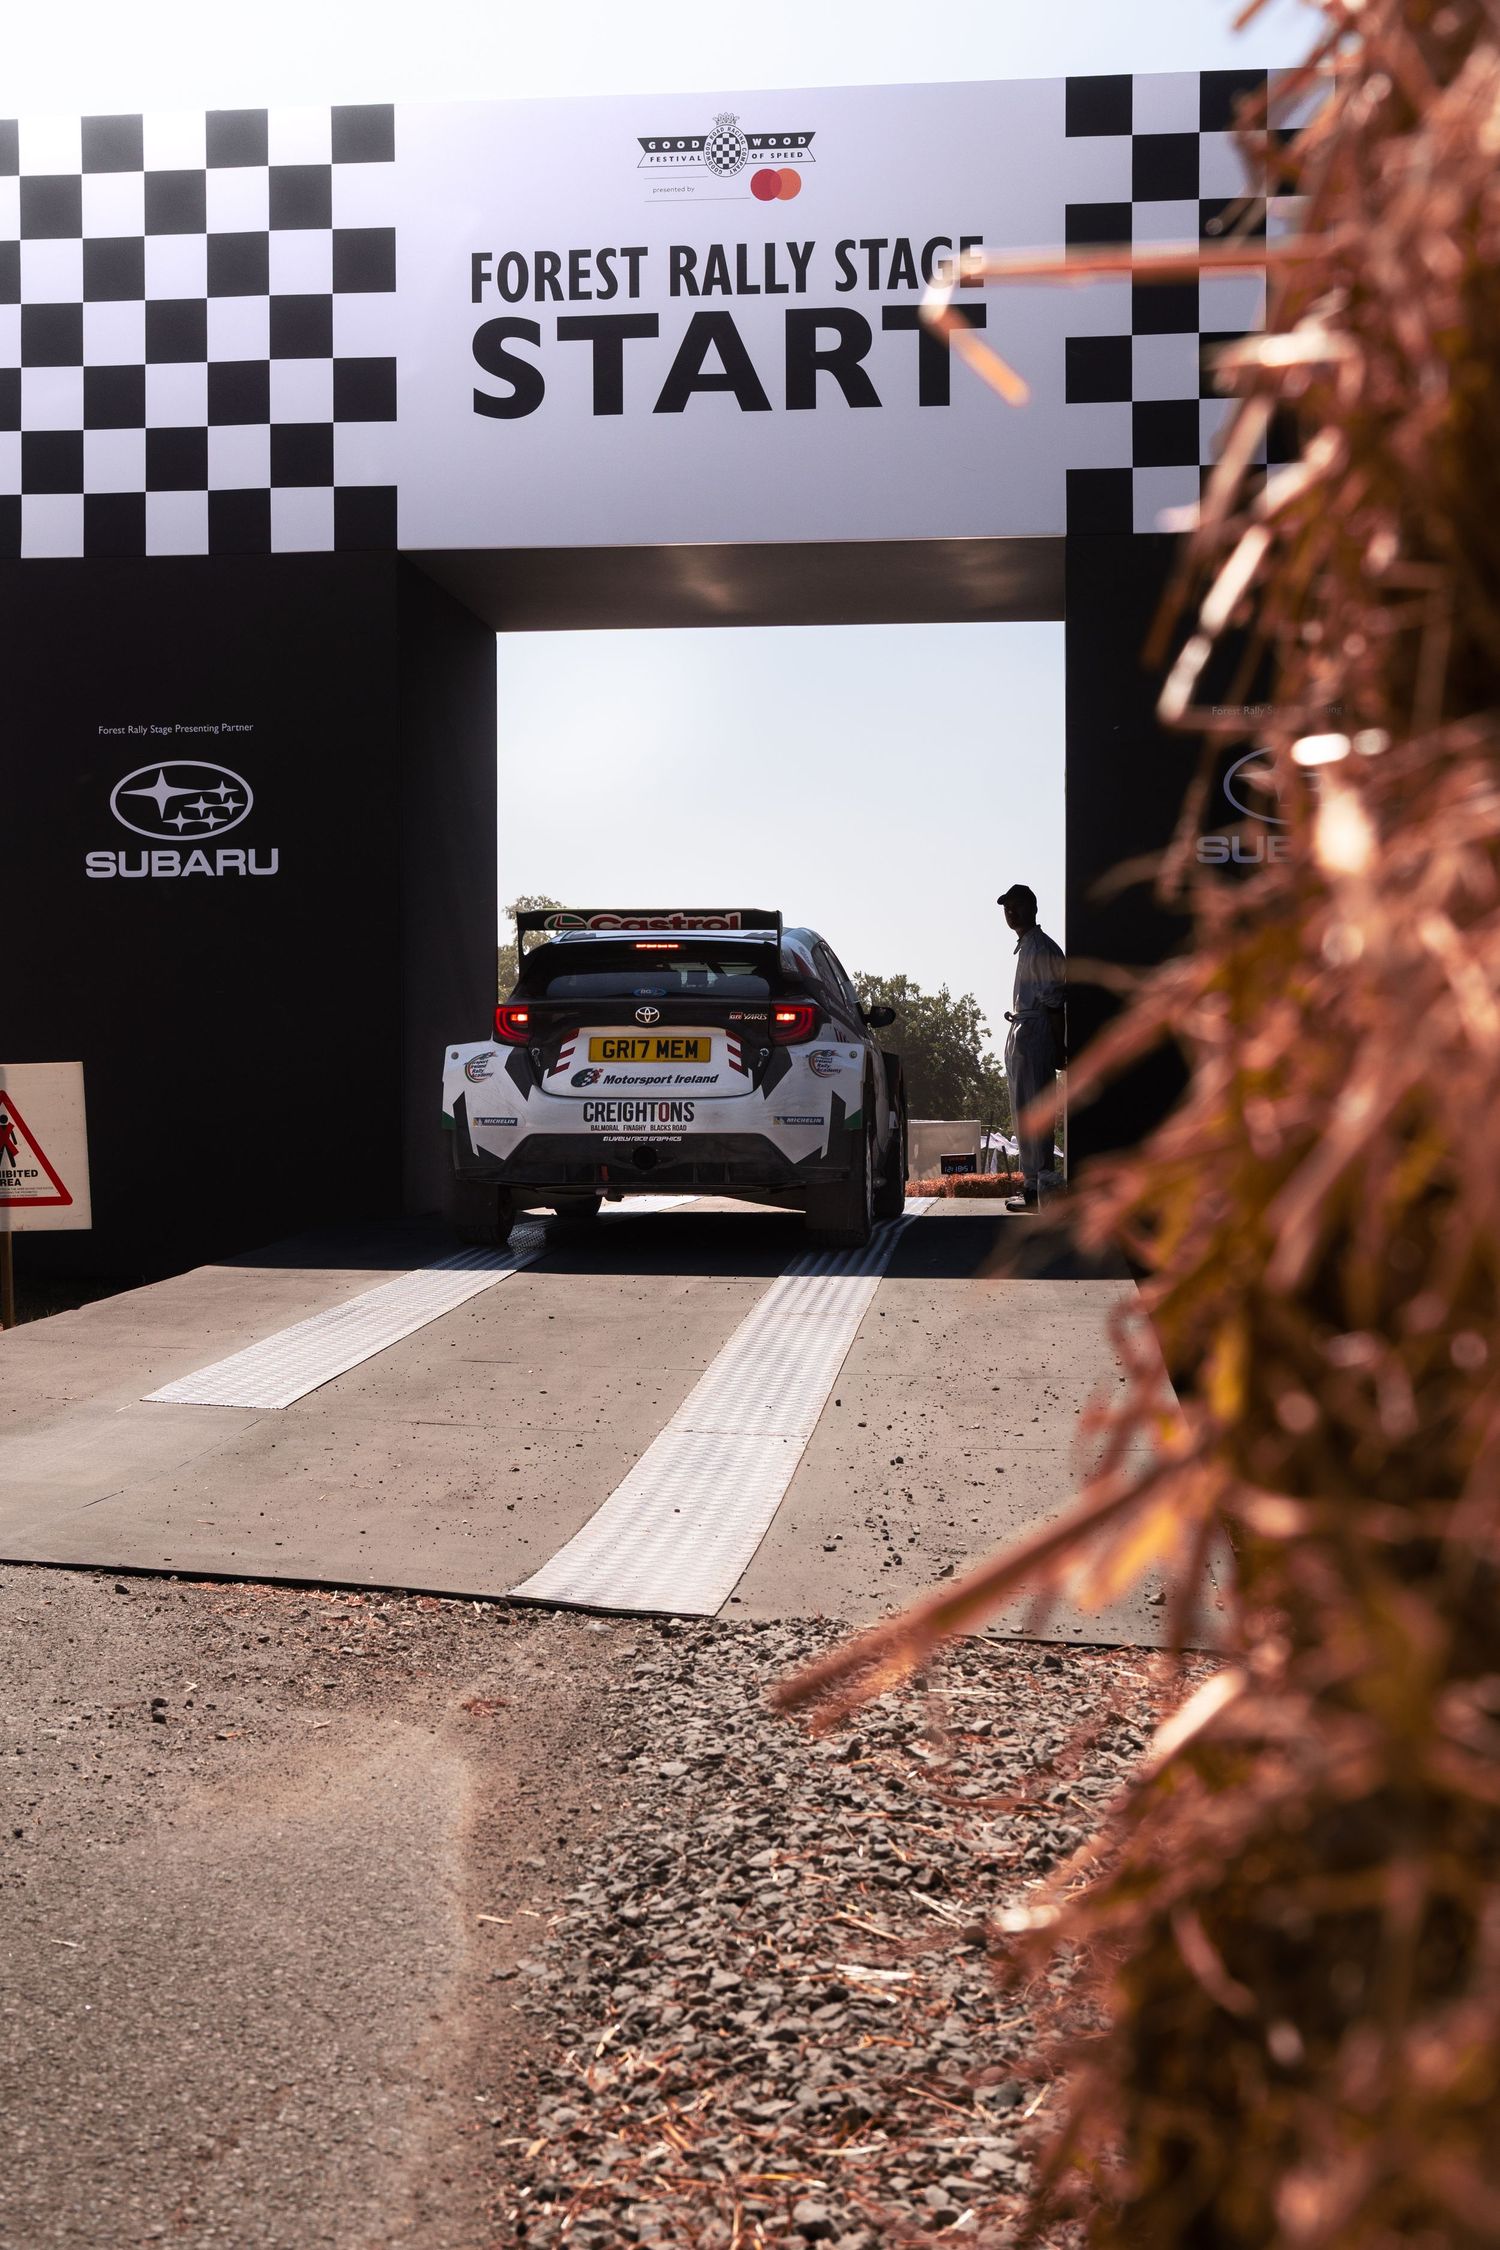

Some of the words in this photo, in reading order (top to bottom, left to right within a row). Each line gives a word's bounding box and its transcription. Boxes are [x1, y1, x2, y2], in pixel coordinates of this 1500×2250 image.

[648, 139, 701, 150] GOOD
[752, 135, 807, 147] WOOD
[649, 154, 702, 163] FESTIVAL
[751, 152, 765, 160] OF
[770, 151, 804, 159] SPEED
[652, 185, 685, 194] presented
[687, 184, 695, 194] by
[471, 245, 648, 303] FOREST
[669, 240, 816, 297] RALLY
[834, 235, 984, 292] STAGE
[471, 302, 987, 420] START
[98, 725, 125, 735] Forest
[128, 724, 147, 736] Rally
[150, 724, 173, 736] Stage
[175, 724, 219, 735] Presenting
[221, 723, 253, 733] Partner
[85, 848, 279, 879] SUBARU
[588, 912, 742, 930] Castrol
[602, 1039, 650, 1059] GR17
[656, 1039, 699, 1059] MEM
[603, 1074, 672, 1086] Motorsport
[673, 1073, 720, 1084] Ireland
[583, 1101, 695, 1123] CREIGHTONS
[0, 1169, 38, 1178] IBITED
